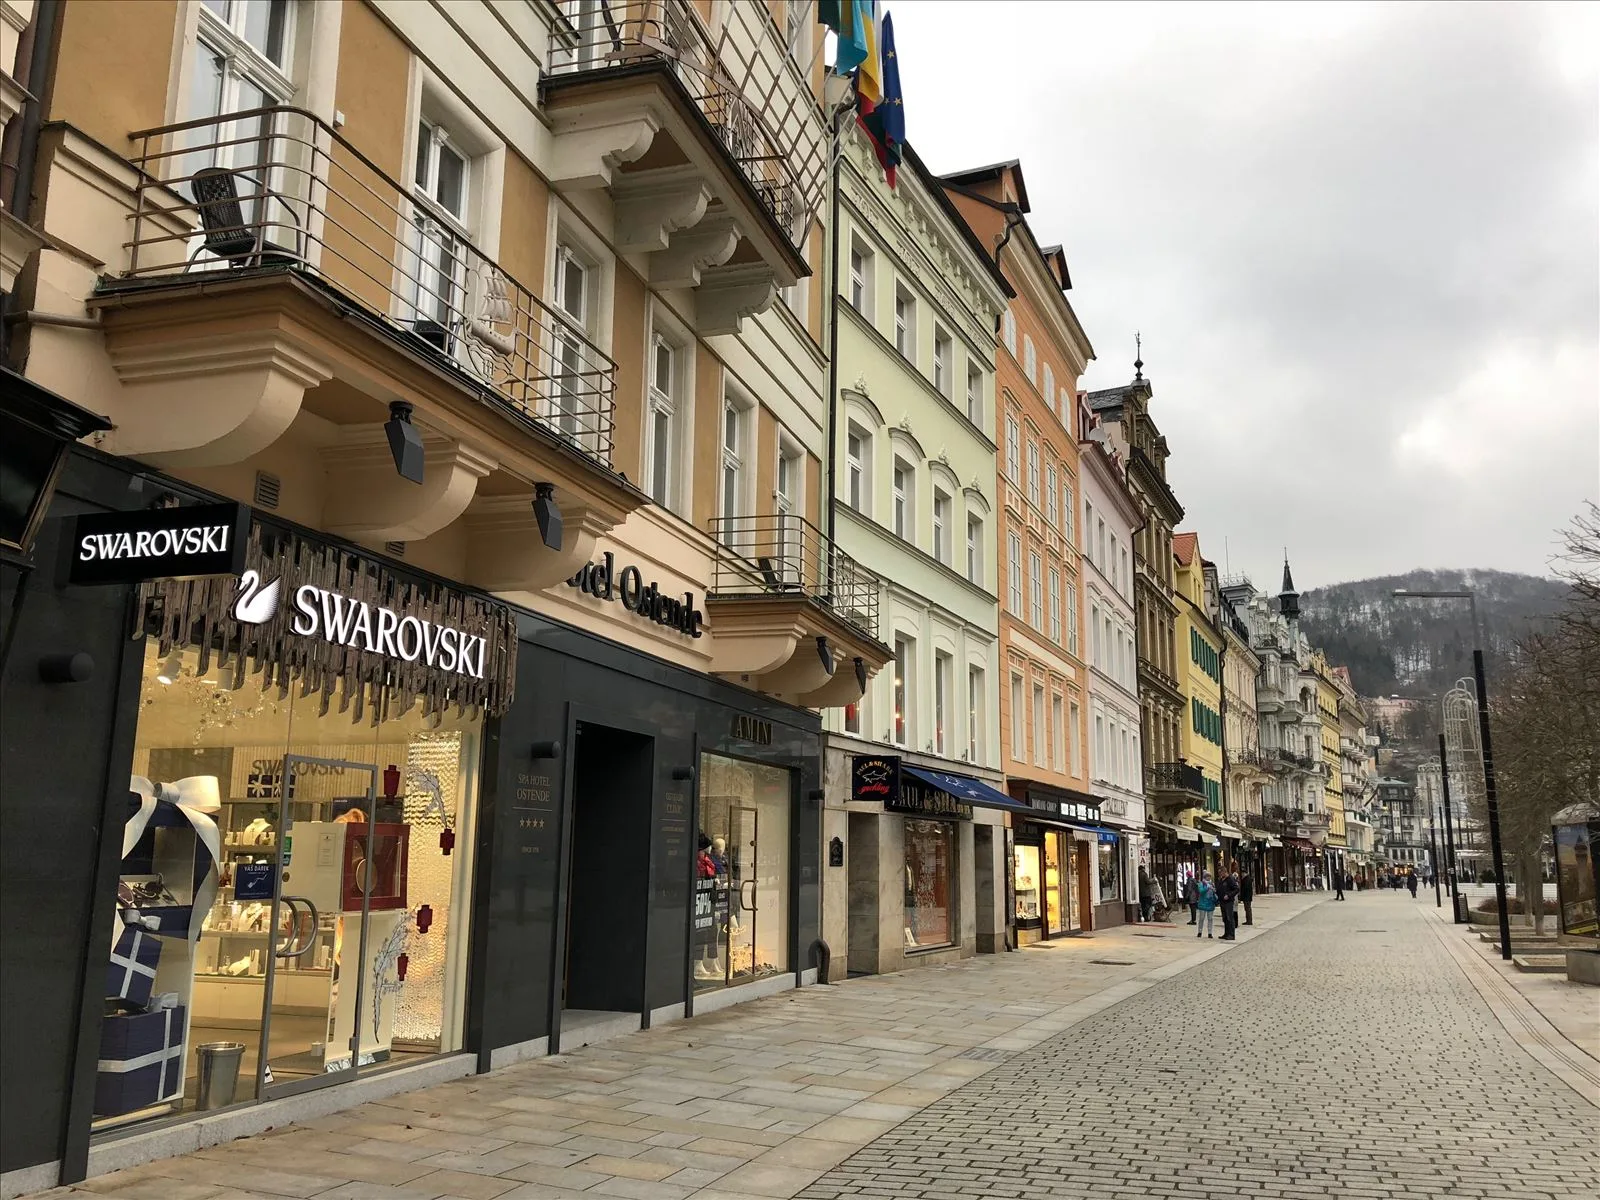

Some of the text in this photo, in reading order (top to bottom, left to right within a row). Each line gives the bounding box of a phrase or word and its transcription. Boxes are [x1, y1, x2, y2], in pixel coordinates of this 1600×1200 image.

[80, 525, 229, 561] SWAROVSKI
[620, 565, 703, 638] Ostende
[293, 584, 487, 679] SWAROVSKI
[518, 773, 550, 786] SPA HOTEL
[516, 788, 551, 801] OSTENDE
[892, 784, 921, 809] AUL
[696, 892, 712, 916] 50%
